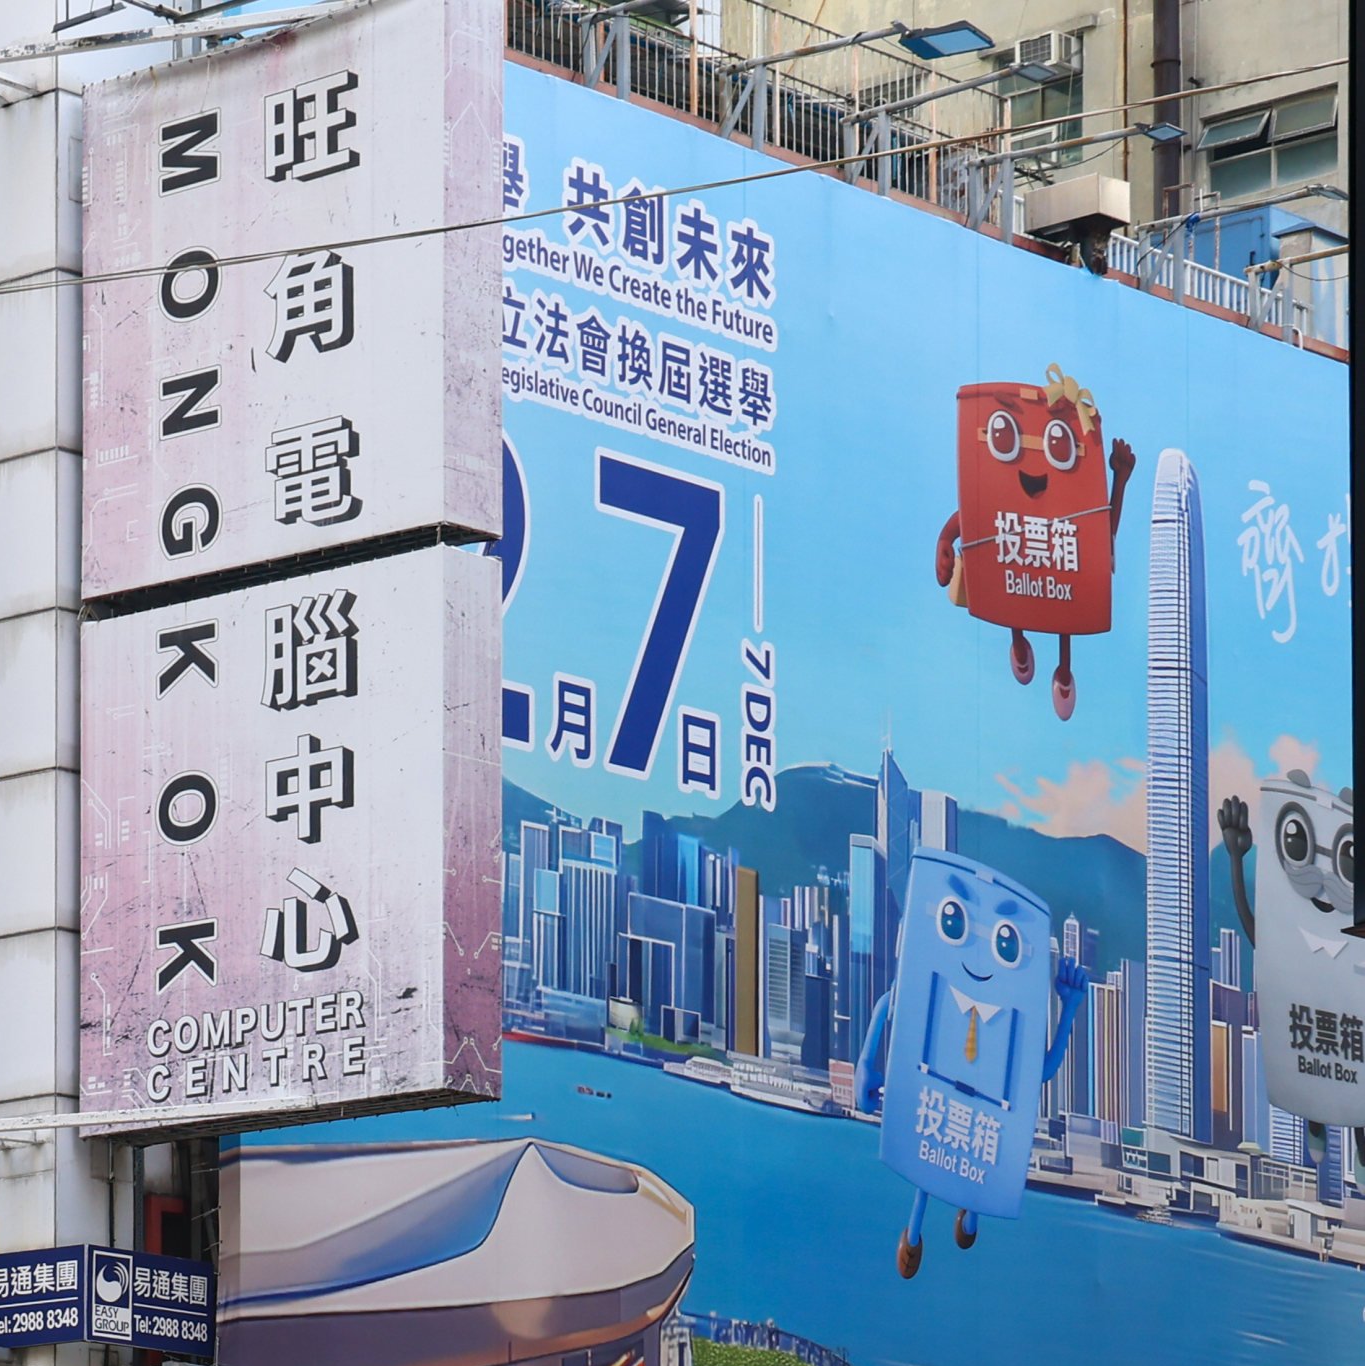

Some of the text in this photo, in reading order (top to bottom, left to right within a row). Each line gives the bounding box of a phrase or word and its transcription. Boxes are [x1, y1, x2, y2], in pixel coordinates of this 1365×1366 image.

[566, 165, 771, 301] 共創未來
[503, 233, 774, 345] gether We Create the Future
[502, 365, 772, 468] egislative Council General Election
[156, 109, 221, 991] MONG KOK
[993, 510, 1080, 573] 投票箱
[1004, 569, 1073, 602] Ballot Box
[146, 990, 366, 1057] COMPUTER
[1288, 1004, 1365, 1063] 投票箱
[146, 1034, 367, 1103] CENTRE
[1297, 1055, 1358, 1085] Ballot Box
[915, 1084, 1002, 1167] 投票箱
[918, 1140, 986, 1185] Ballot Box
[95, 1304, 119, 1319] EASY
[133, 1265, 209, 1308] 易通集團
[46, 1307, 79, 1330] 8348
[95, 1317, 130, 1333] GROUP
[181, 1320, 208, 1343] 8348
